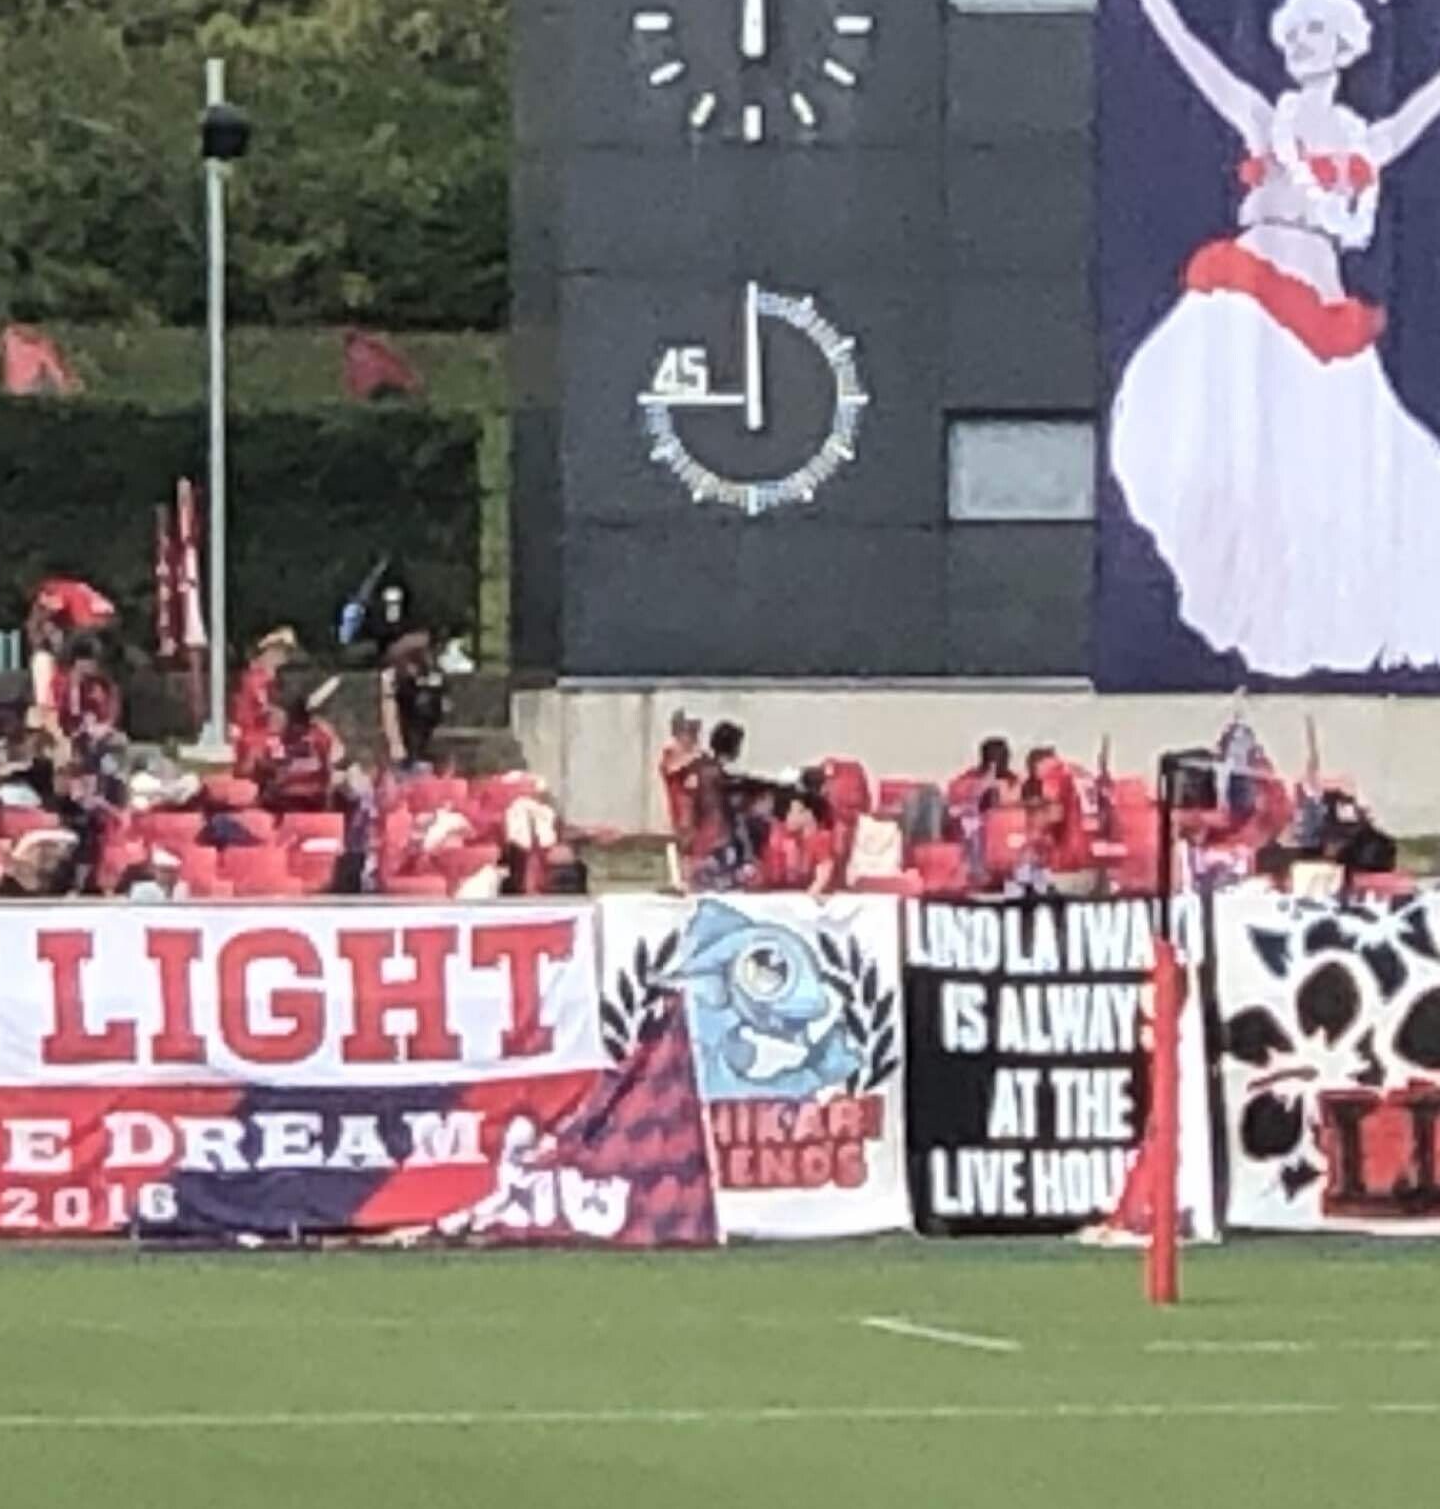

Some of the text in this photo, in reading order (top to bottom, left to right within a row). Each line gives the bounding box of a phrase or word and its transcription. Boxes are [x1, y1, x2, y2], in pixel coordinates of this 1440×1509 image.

[650, 346, 709, 394] 45
[906, 896, 1001, 972] LINO
[1004, 902, 1060, 973] LA
[37, 920, 575, 1065] LIGHT
[942, 983, 987, 1052] IS
[987, 1068, 1134, 1139] AT THE
[103, 1110, 488, 1173] DREAM
[929, 1146, 1027, 1217] LIVE
